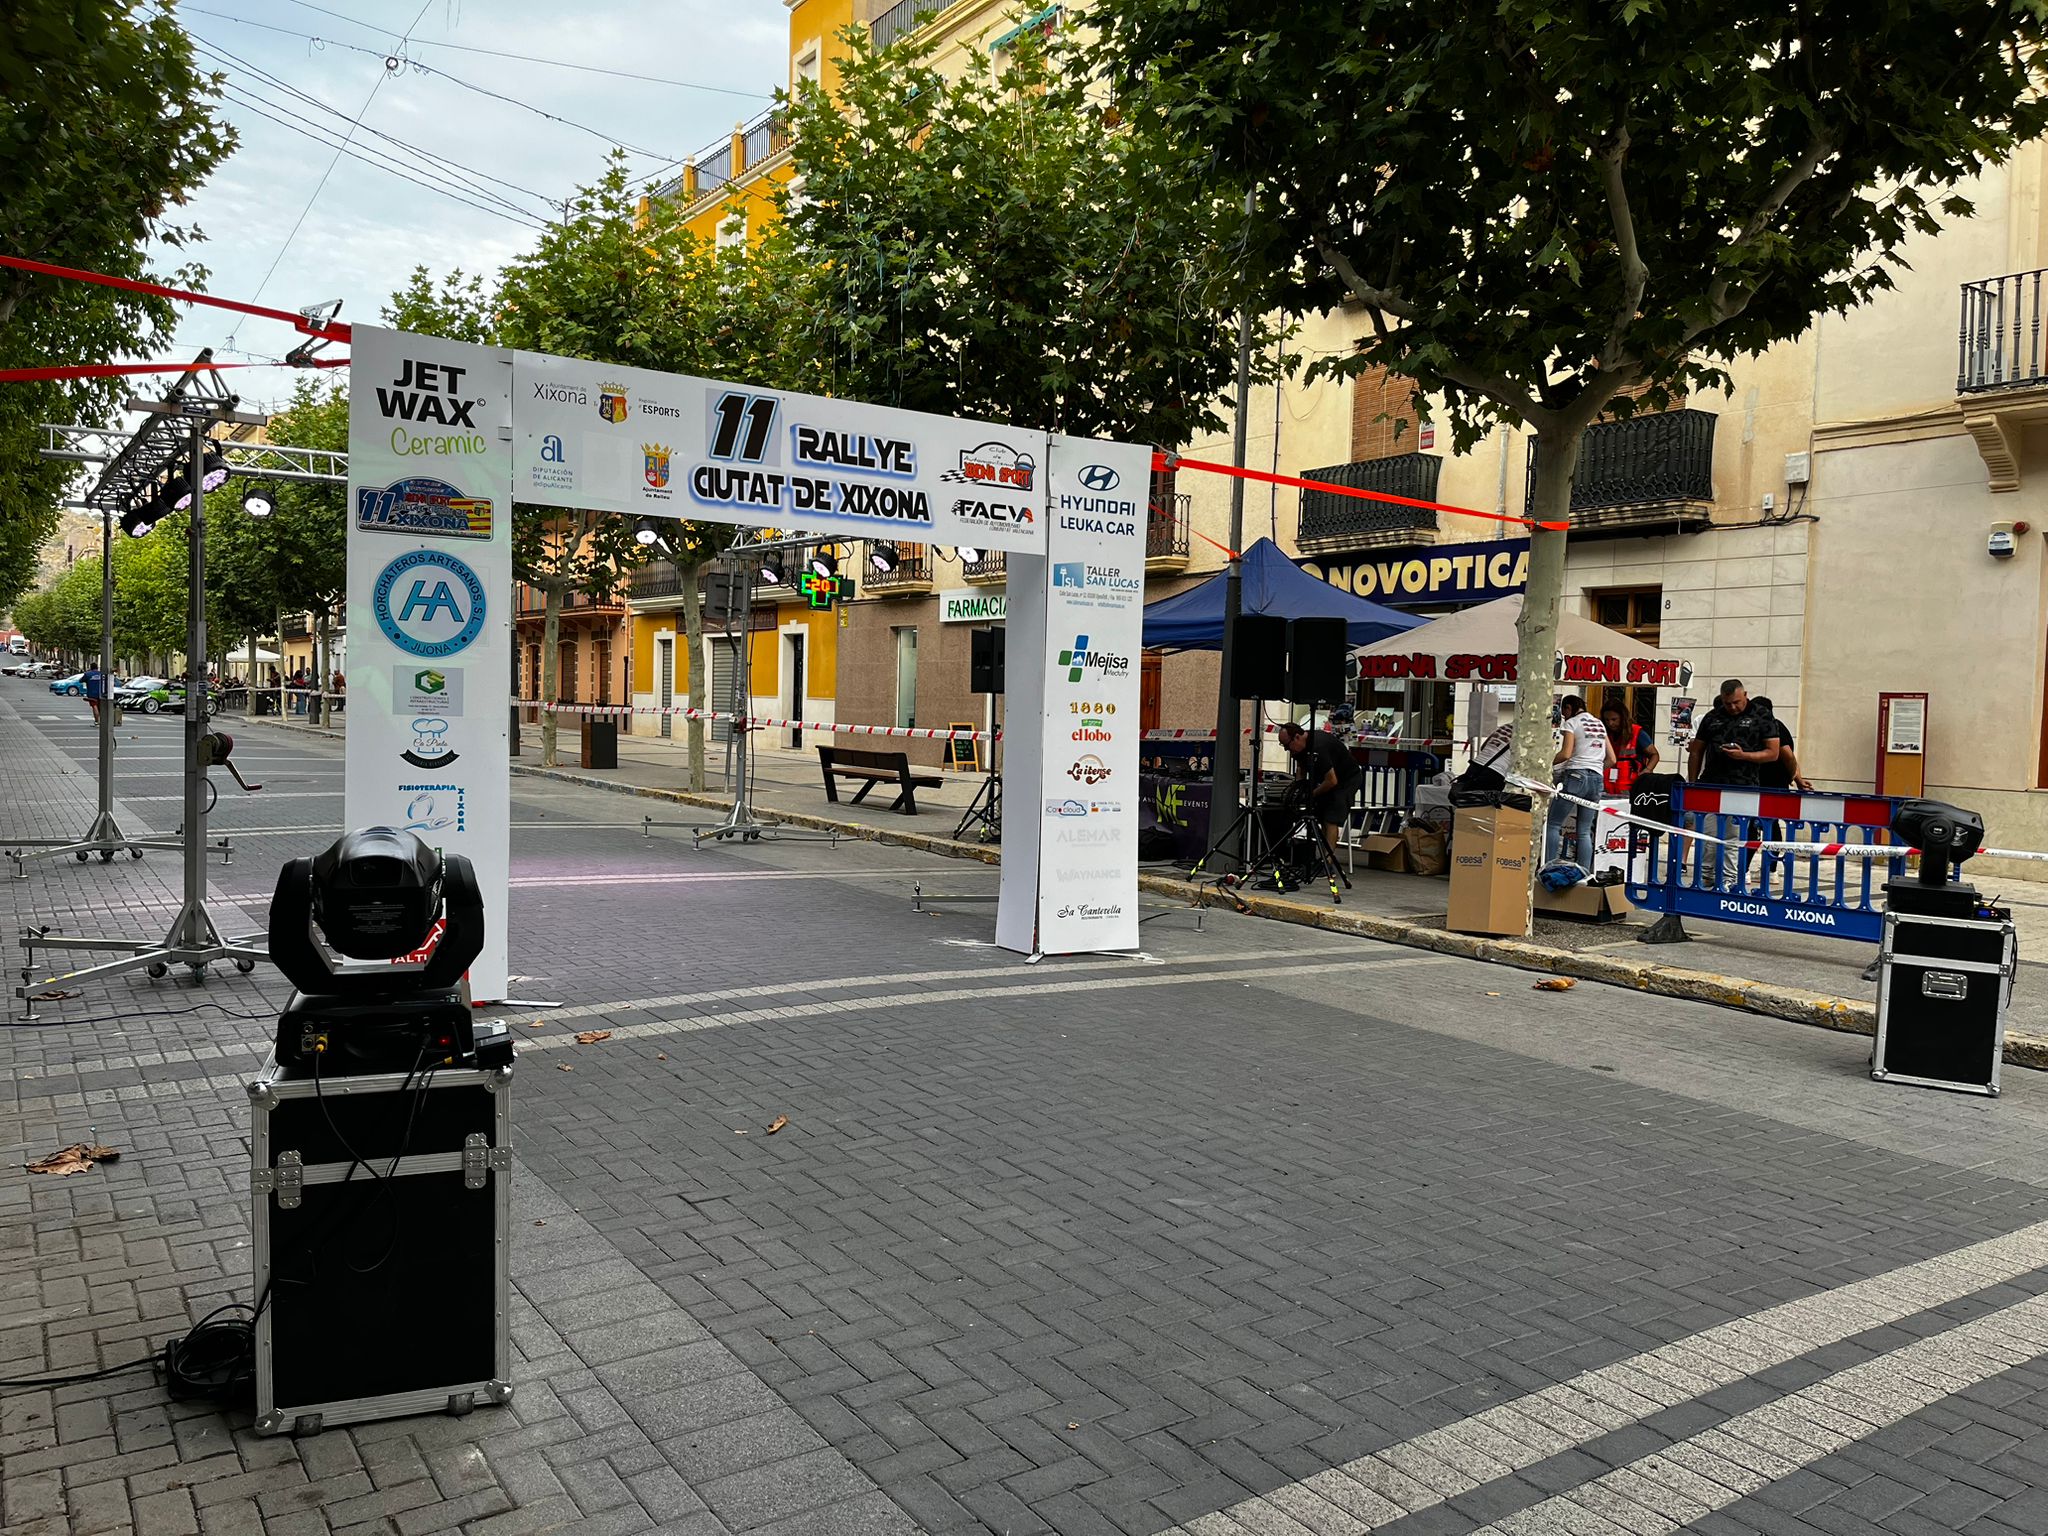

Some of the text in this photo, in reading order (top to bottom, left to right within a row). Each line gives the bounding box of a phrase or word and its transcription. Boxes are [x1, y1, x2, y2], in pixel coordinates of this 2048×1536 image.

[393, 359, 466, 395] JET
[534, 382, 587, 405] Xixona
[376, 387, 476, 429] WAX
[711, 392, 778, 463] 11
[391, 427, 487, 456] Ceramic
[798, 427, 913, 473] RALLYE
[543, 475, 573, 483] ALICANTE
[999, 466, 1031, 487] SPORT
[694, 466, 931, 522] CIUTAT DE XIXONA
[1060, 494, 1136, 517] HYUNDAI
[360, 491, 396, 524] 11
[953, 499, 1034, 524] FACVA
[396, 513, 471, 530] XIXONA
[1060, 515, 1135, 536] LEUKA CAR
[1086, 566, 1121, 578] TALLER
[1086, 576, 1140, 589] SAN LUCAS
[377, 554, 427, 621] HORCHATEROS
[1664, 599, 1671, 610] 8
[411, 642, 452, 655] JIJONA
[1084, 651, 1129, 676] Mejisa
[1359, 653, 1518, 681] XIXONA SPOR
[1563, 654, 1679, 685] XIXONA SPORT
[1069, 701, 1116, 715] 1880
[1071, 729, 1112, 742] el lobo
[1184, 800, 1209, 809] EVENTS
[1056, 829, 1121, 843] ALEMAR
[1844, 847, 1886, 857] Xixona
[1077, 904, 1121, 917] Canterella
[1720, 900, 1836, 926] POLICIA XIXONA
